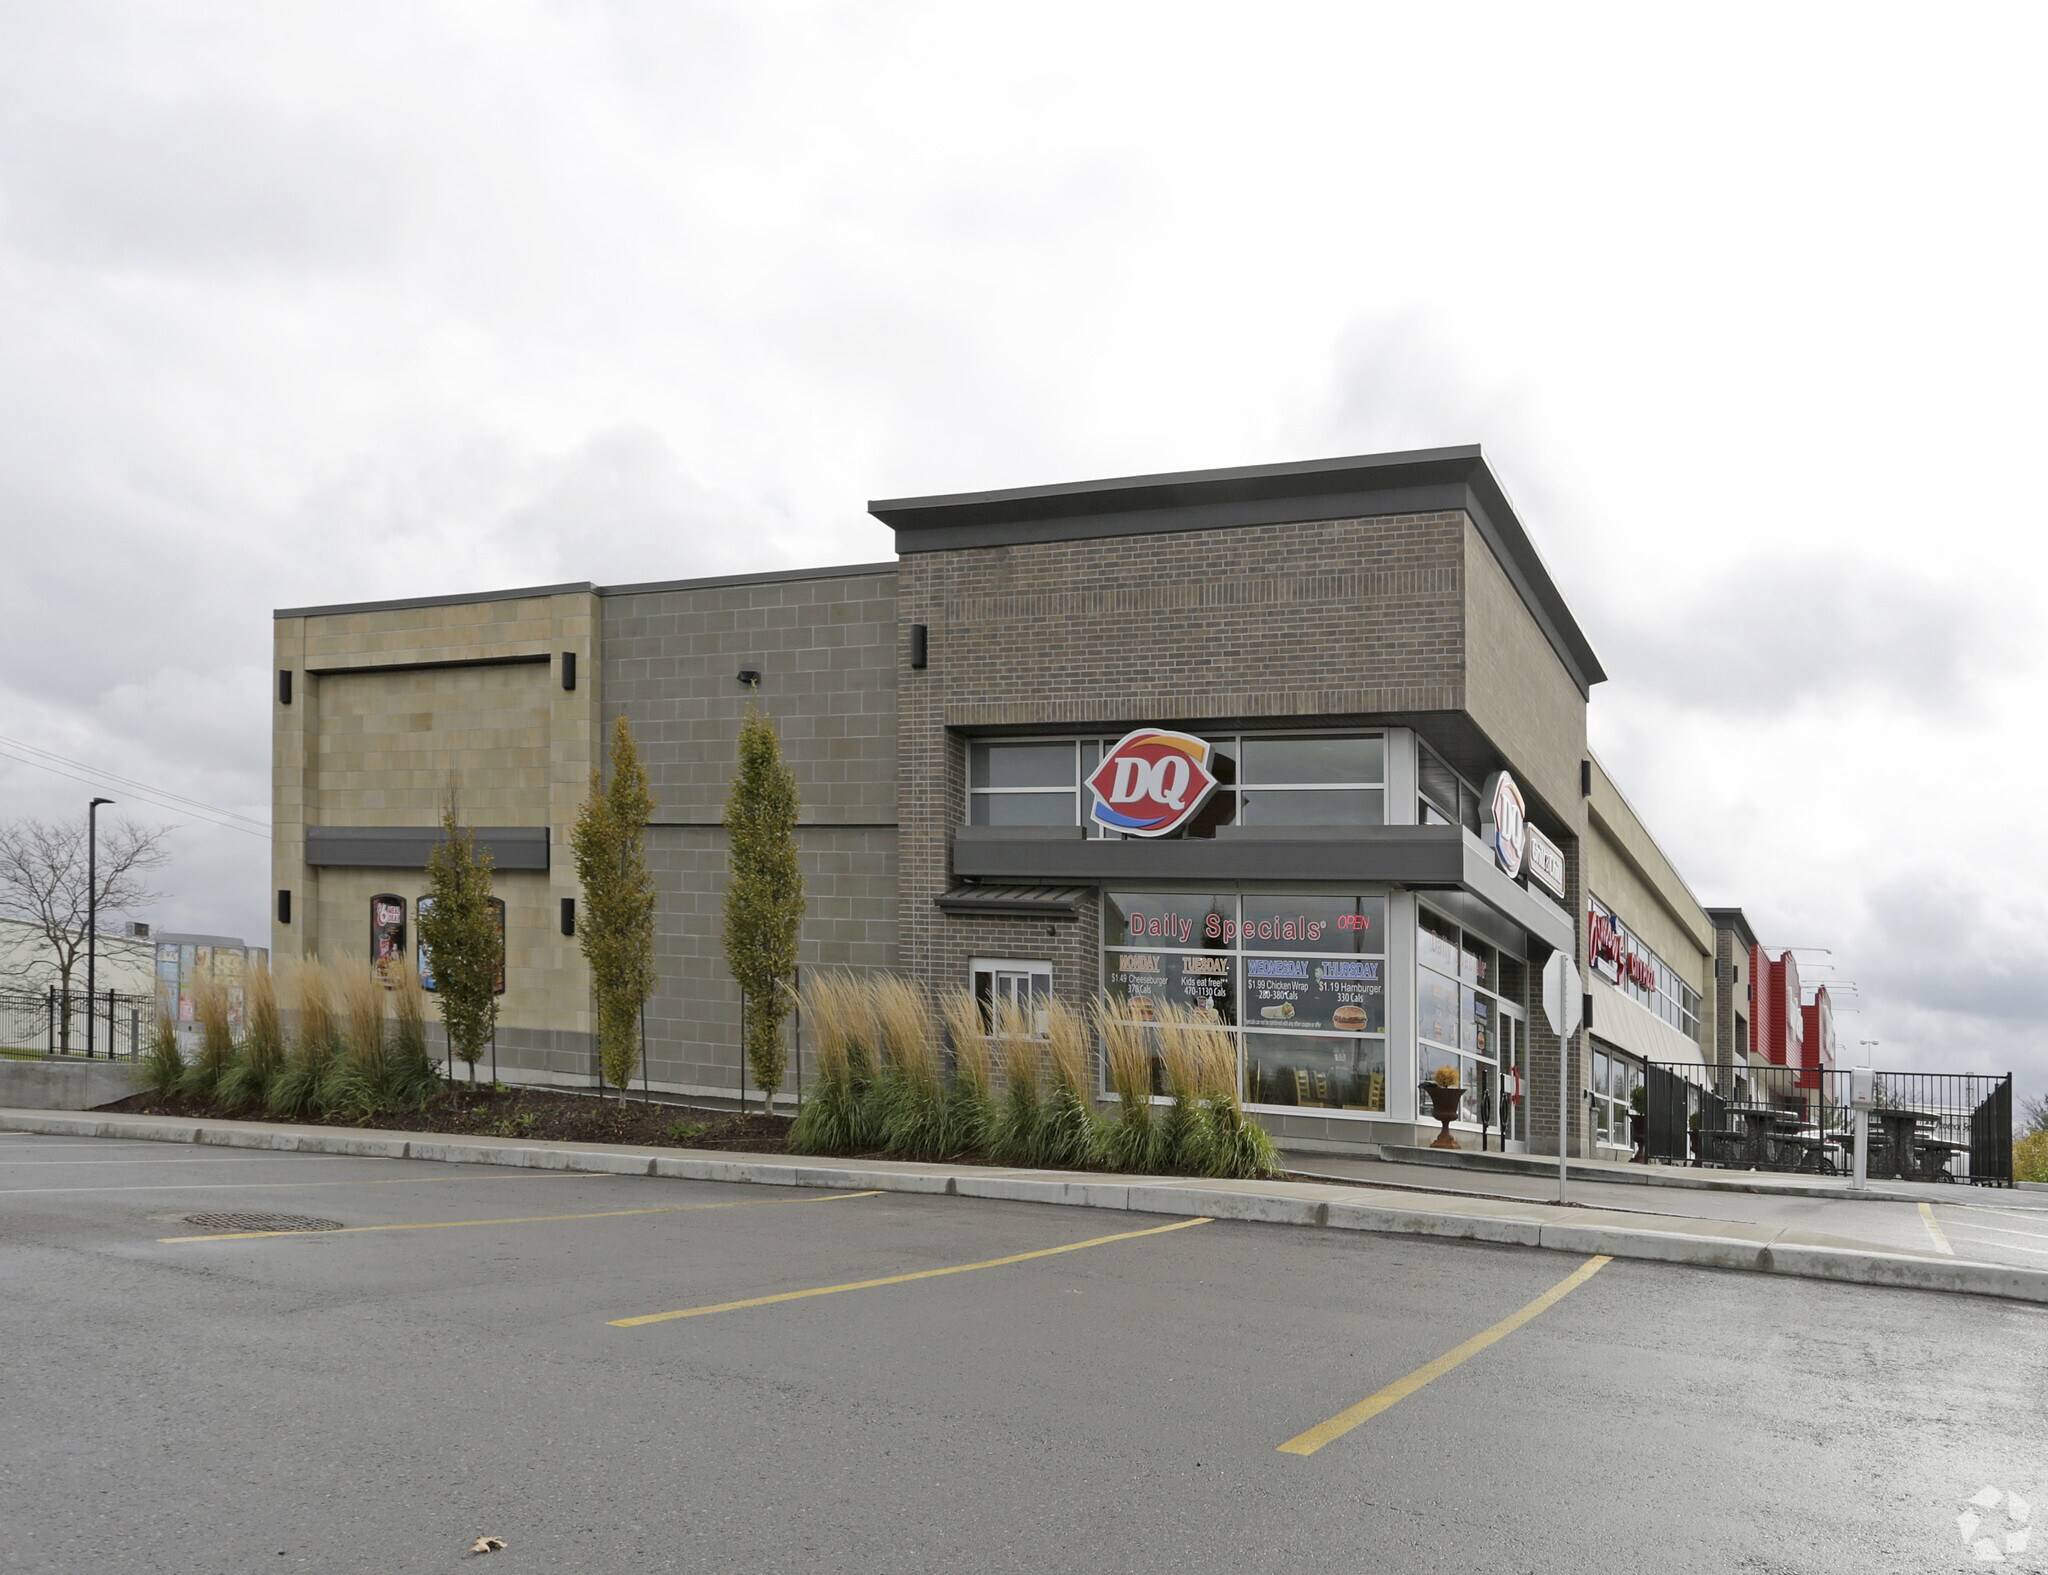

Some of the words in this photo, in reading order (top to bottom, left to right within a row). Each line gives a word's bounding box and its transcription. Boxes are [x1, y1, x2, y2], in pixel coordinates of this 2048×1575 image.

[1109, 755, 1191, 811] DQ
[1501, 793, 1523, 861] DQ
[1131, 912, 1193, 943] Daily
[1337, 914, 1370, 930] OPEN
[1119, 954, 1160, 972] MONDAY
[1182, 956, 1228, 974] TUESDAY
[1247, 959, 1309, 977] WEDNESDAY
[1321, 961, 1379, 979] THURSDAY
[1111, 973, 1127, 983] $1.49
[1128, 974, 1168, 986] Cheeseburger
[1181, 976, 1196, 987] Kids
[1196, 978, 1208, 987] eat
[1247, 979, 1266, 990] $1.99
[1266, 980, 1292, 991] Chicken
[1291, 981, 1309, 992] Wrap
[1139, 985, 1152, 995] Cals
[1184, 985, 1213, 996] 470-1130
[1213, 987, 1227, 997] Cals
[1258, 989, 1286, 999] 280-380
[1285, 990, 1299, 1001] Cals
[1318, 981, 1340, 992] $1.19
[1340, 981, 1382, 996] Hamburger
[1337, 993, 1350, 1002] 330
[1350, 993, 1364, 1003] Cals
